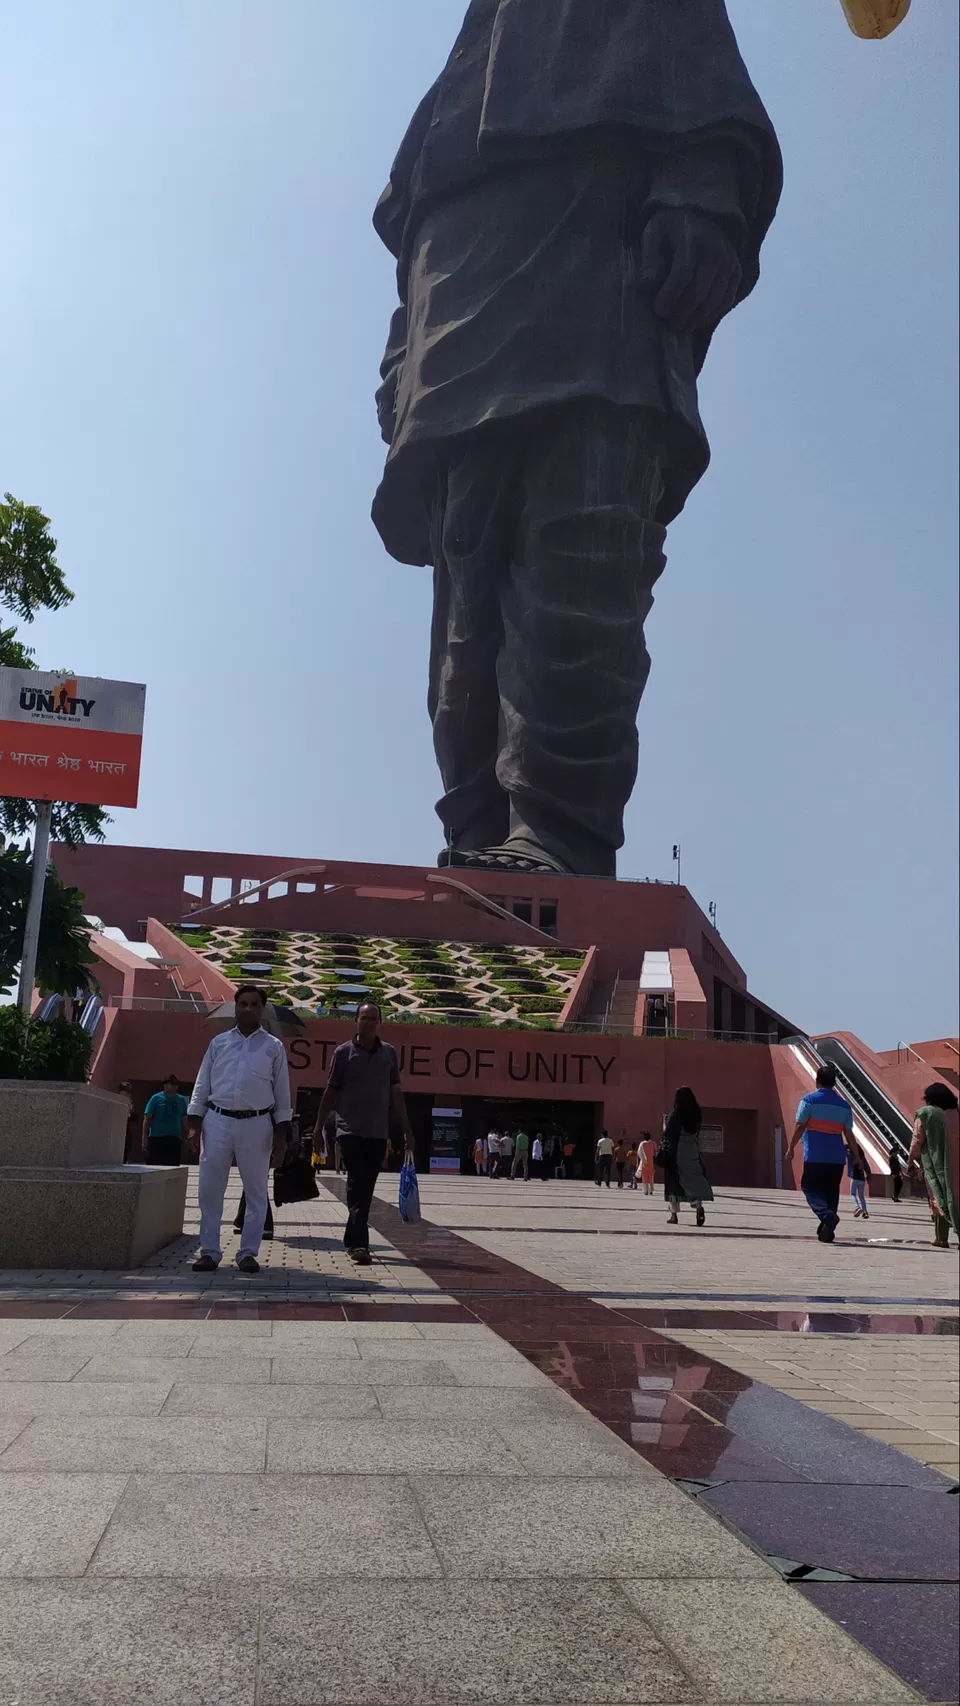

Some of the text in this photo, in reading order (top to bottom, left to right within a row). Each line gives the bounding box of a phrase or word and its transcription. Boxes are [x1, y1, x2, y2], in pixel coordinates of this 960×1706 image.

[21, 687, 43, 695] STATUE
[10, 751, 50, 768] भारत
[56, 752, 82, 771] श्रेष्ठ
[88, 760, 126, 775] भारत
[288, 1039, 616, 1085] STE OF UNITY
